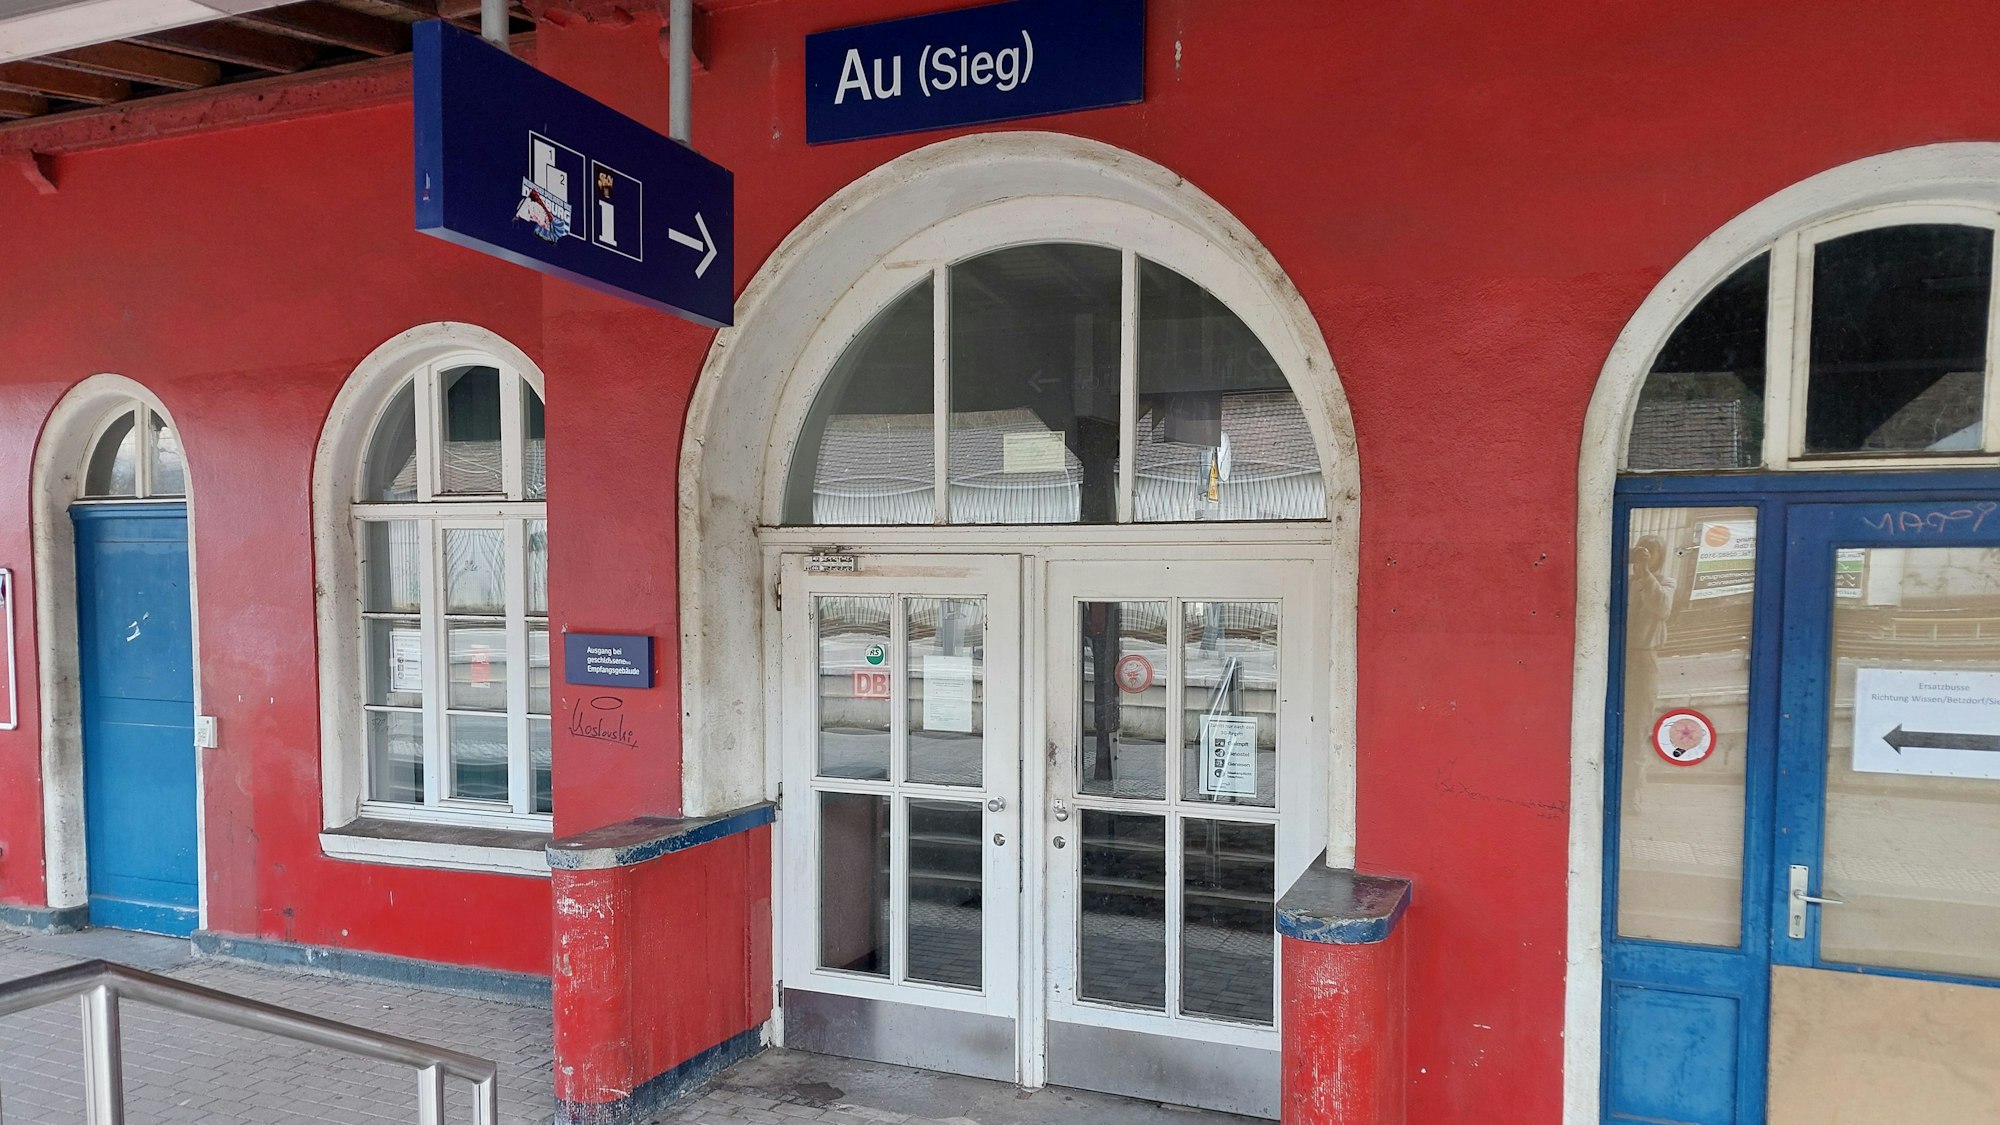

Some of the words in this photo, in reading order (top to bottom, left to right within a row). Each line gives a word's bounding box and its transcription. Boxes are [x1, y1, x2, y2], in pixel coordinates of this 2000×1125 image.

[834, 48, 902, 105] Au
[919, 30, 1034, 97] (Sieg)
[586, 646, 612, 656] Ausgang
[612, 647, 622, 656] bei
[587, 665, 640, 676] Empfangsgebäude
[856, 673, 887, 695] DB
[1918, 682, 1971, 692] Ersatzbusse
[1871, 693, 1910, 703] Richtung
[1227, 740, 1249, 748] Gimpft
